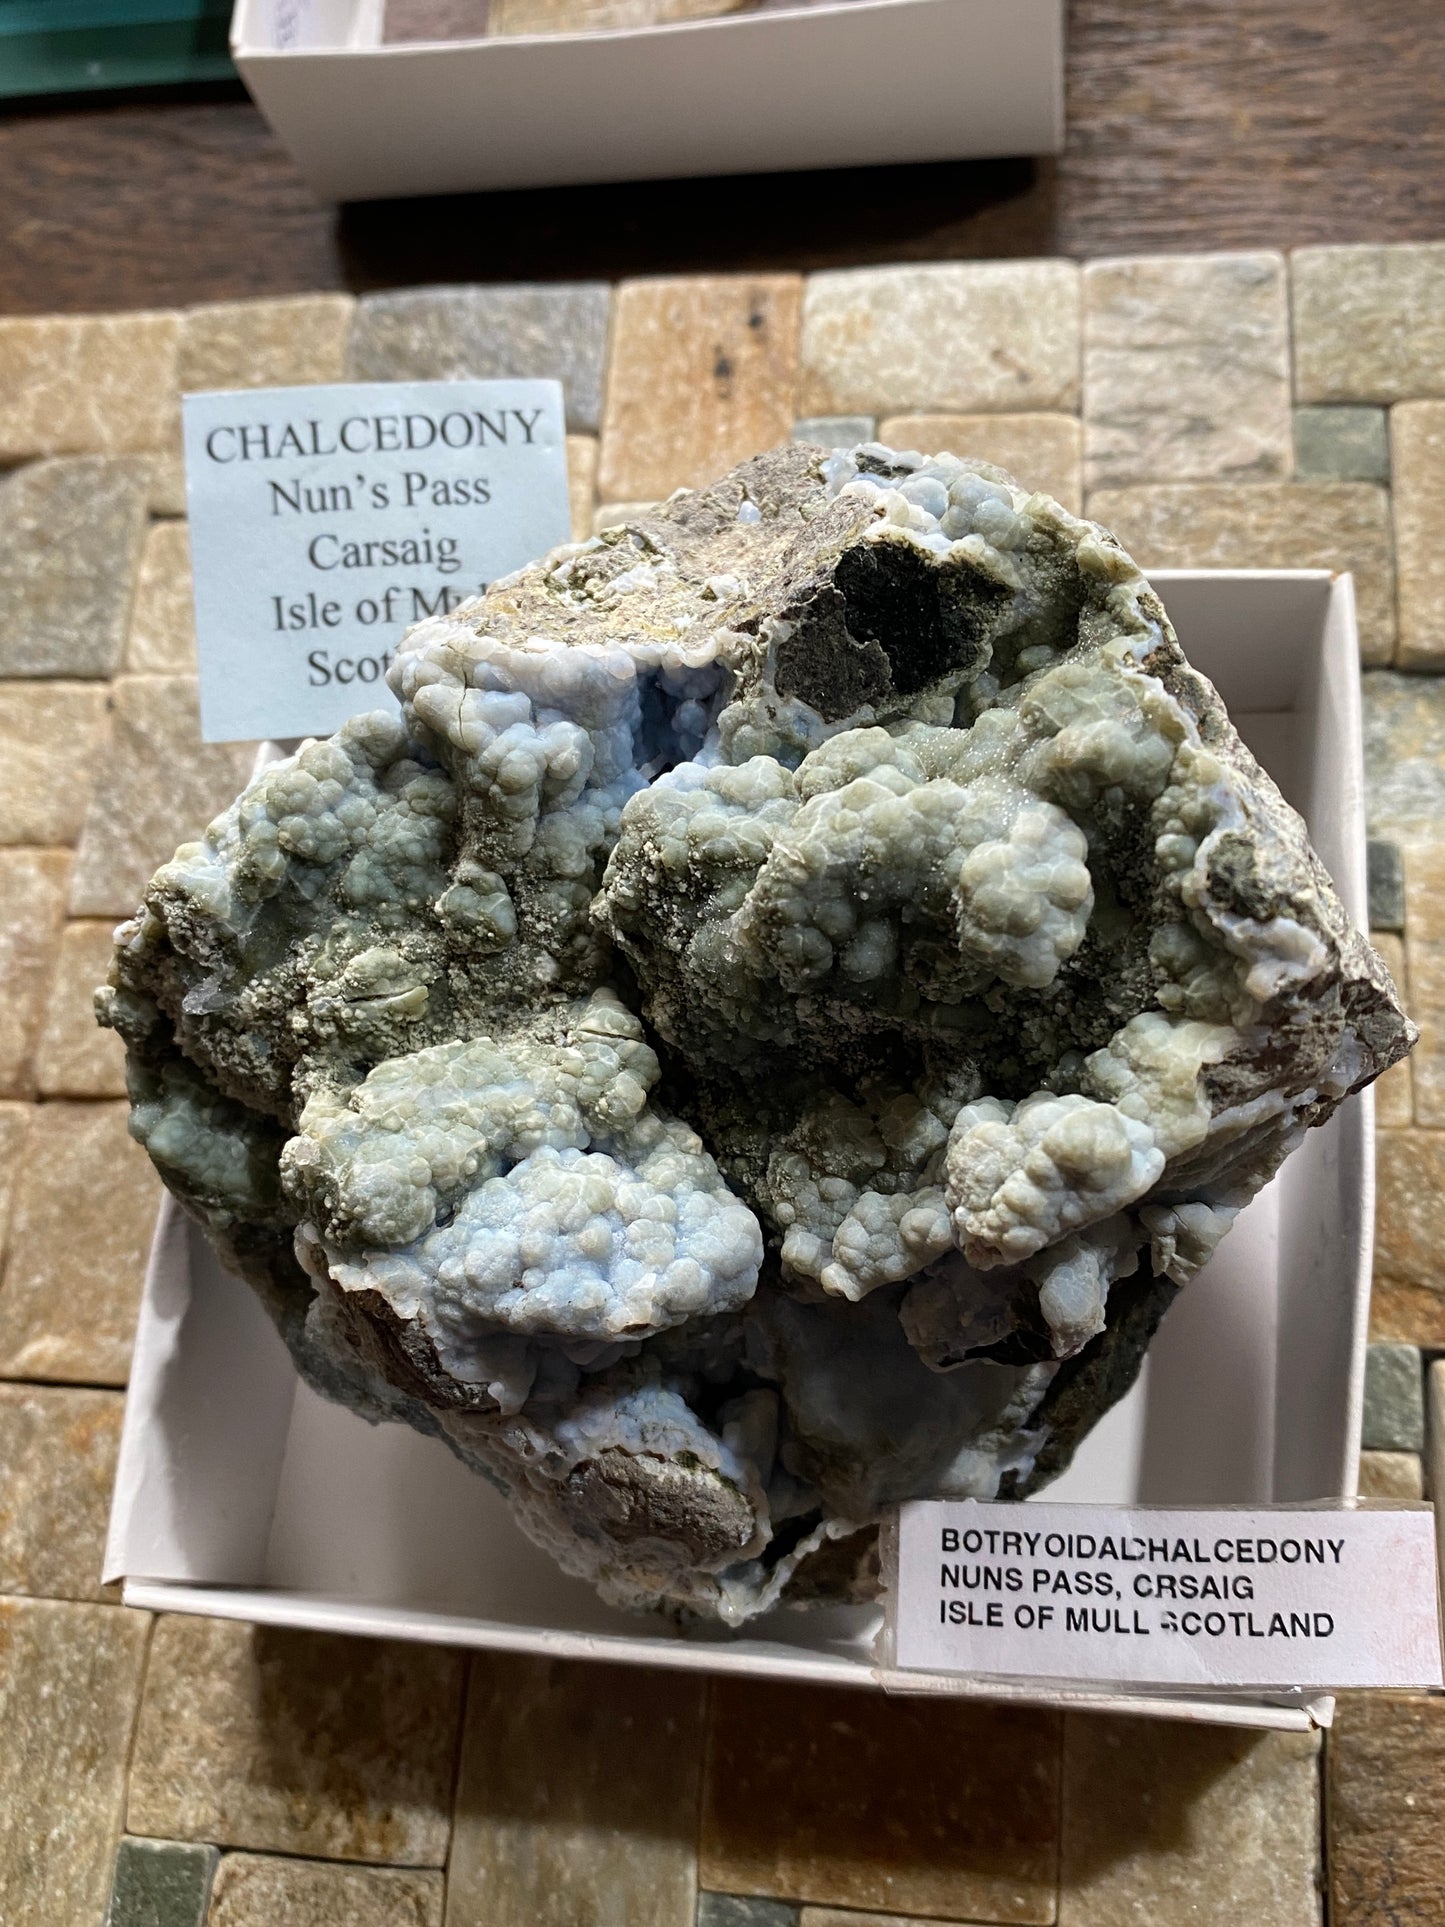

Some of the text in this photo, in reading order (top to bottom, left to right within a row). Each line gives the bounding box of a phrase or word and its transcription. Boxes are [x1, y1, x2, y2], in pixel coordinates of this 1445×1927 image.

[205, 408, 544, 464] CHALCEDONY
[268, 471, 491, 516] Nun's Pass
[308, 528, 462, 573] Carsaig
[271, 591, 341, 632] Isle
[355, 586, 401, 626] of
[940, 1563, 1255, 1601] NUNS PASS, CRSAIG
[940, 1599, 1005, 1628] ISLE
[1014, 1604, 1055, 1630] OF
[1065, 1606, 1150, 1635] MULL
